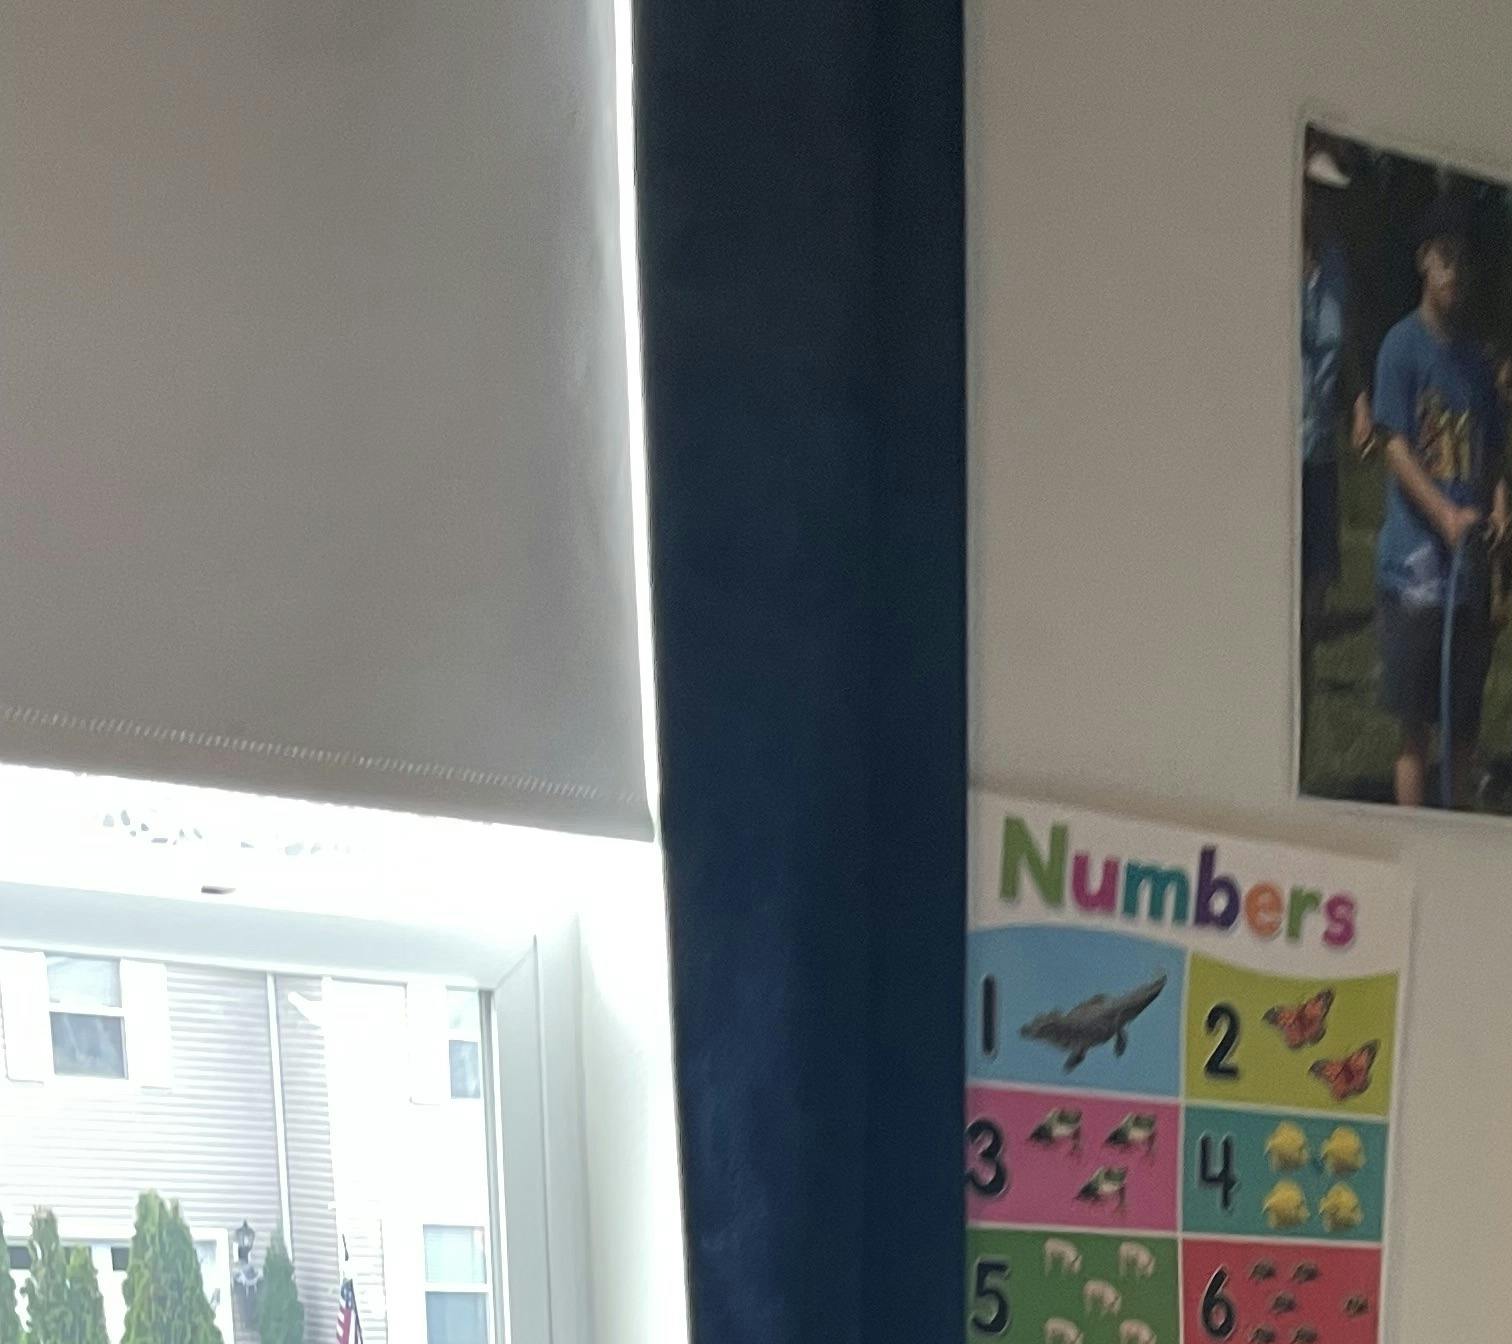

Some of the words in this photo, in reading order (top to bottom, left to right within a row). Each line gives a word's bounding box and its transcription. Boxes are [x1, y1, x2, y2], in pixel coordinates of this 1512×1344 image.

[997, 815, 1360, 950] Numbers
[979, 973, 998, 1057] 1
[1201, 1002, 1241, 1081] 2
[965, 1117, 1011, 1199] 3
[1197, 1131, 1241, 1213] 4
[971, 1256, 1014, 1340] 5
